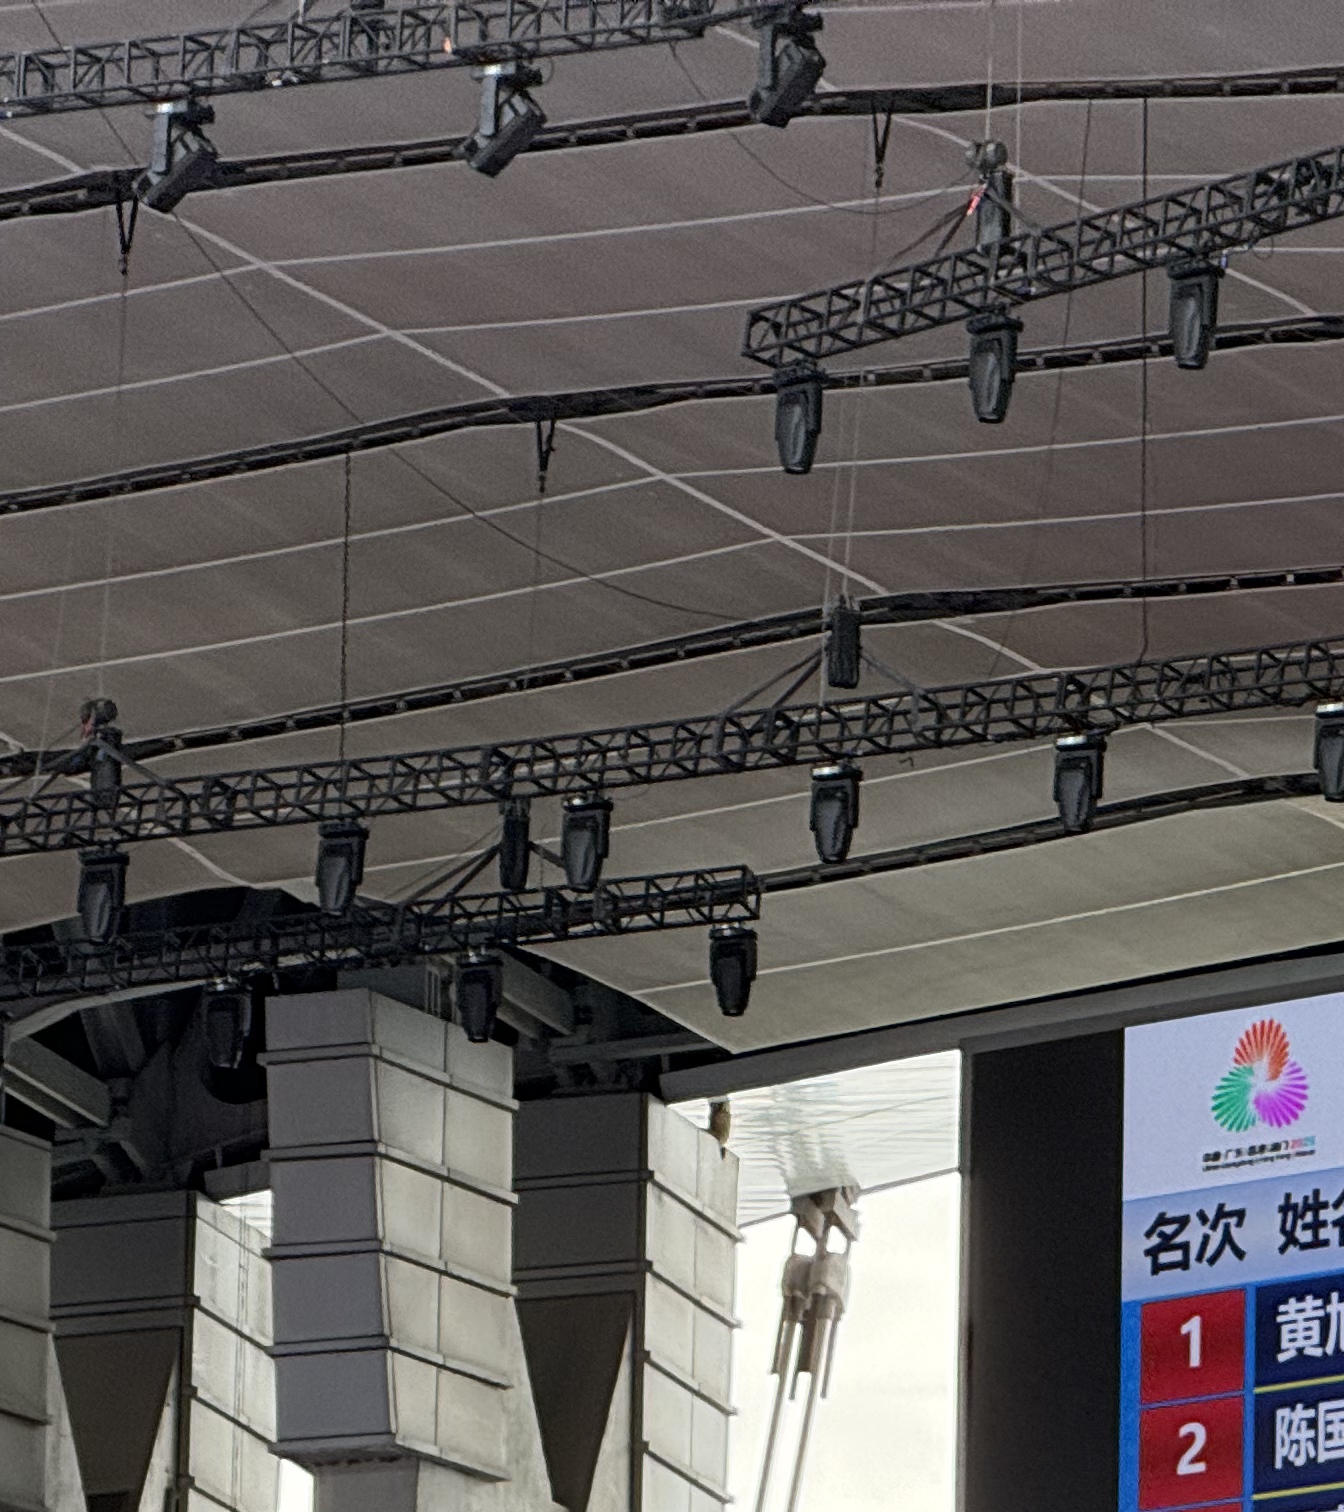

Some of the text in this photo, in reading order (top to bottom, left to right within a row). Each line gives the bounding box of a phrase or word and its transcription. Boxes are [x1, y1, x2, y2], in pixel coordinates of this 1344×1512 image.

[1143, 1201, 1246, 1274] 名次
[1181, 1316, 1200, 1366] 1
[1178, 1423, 1205, 1474] 2
